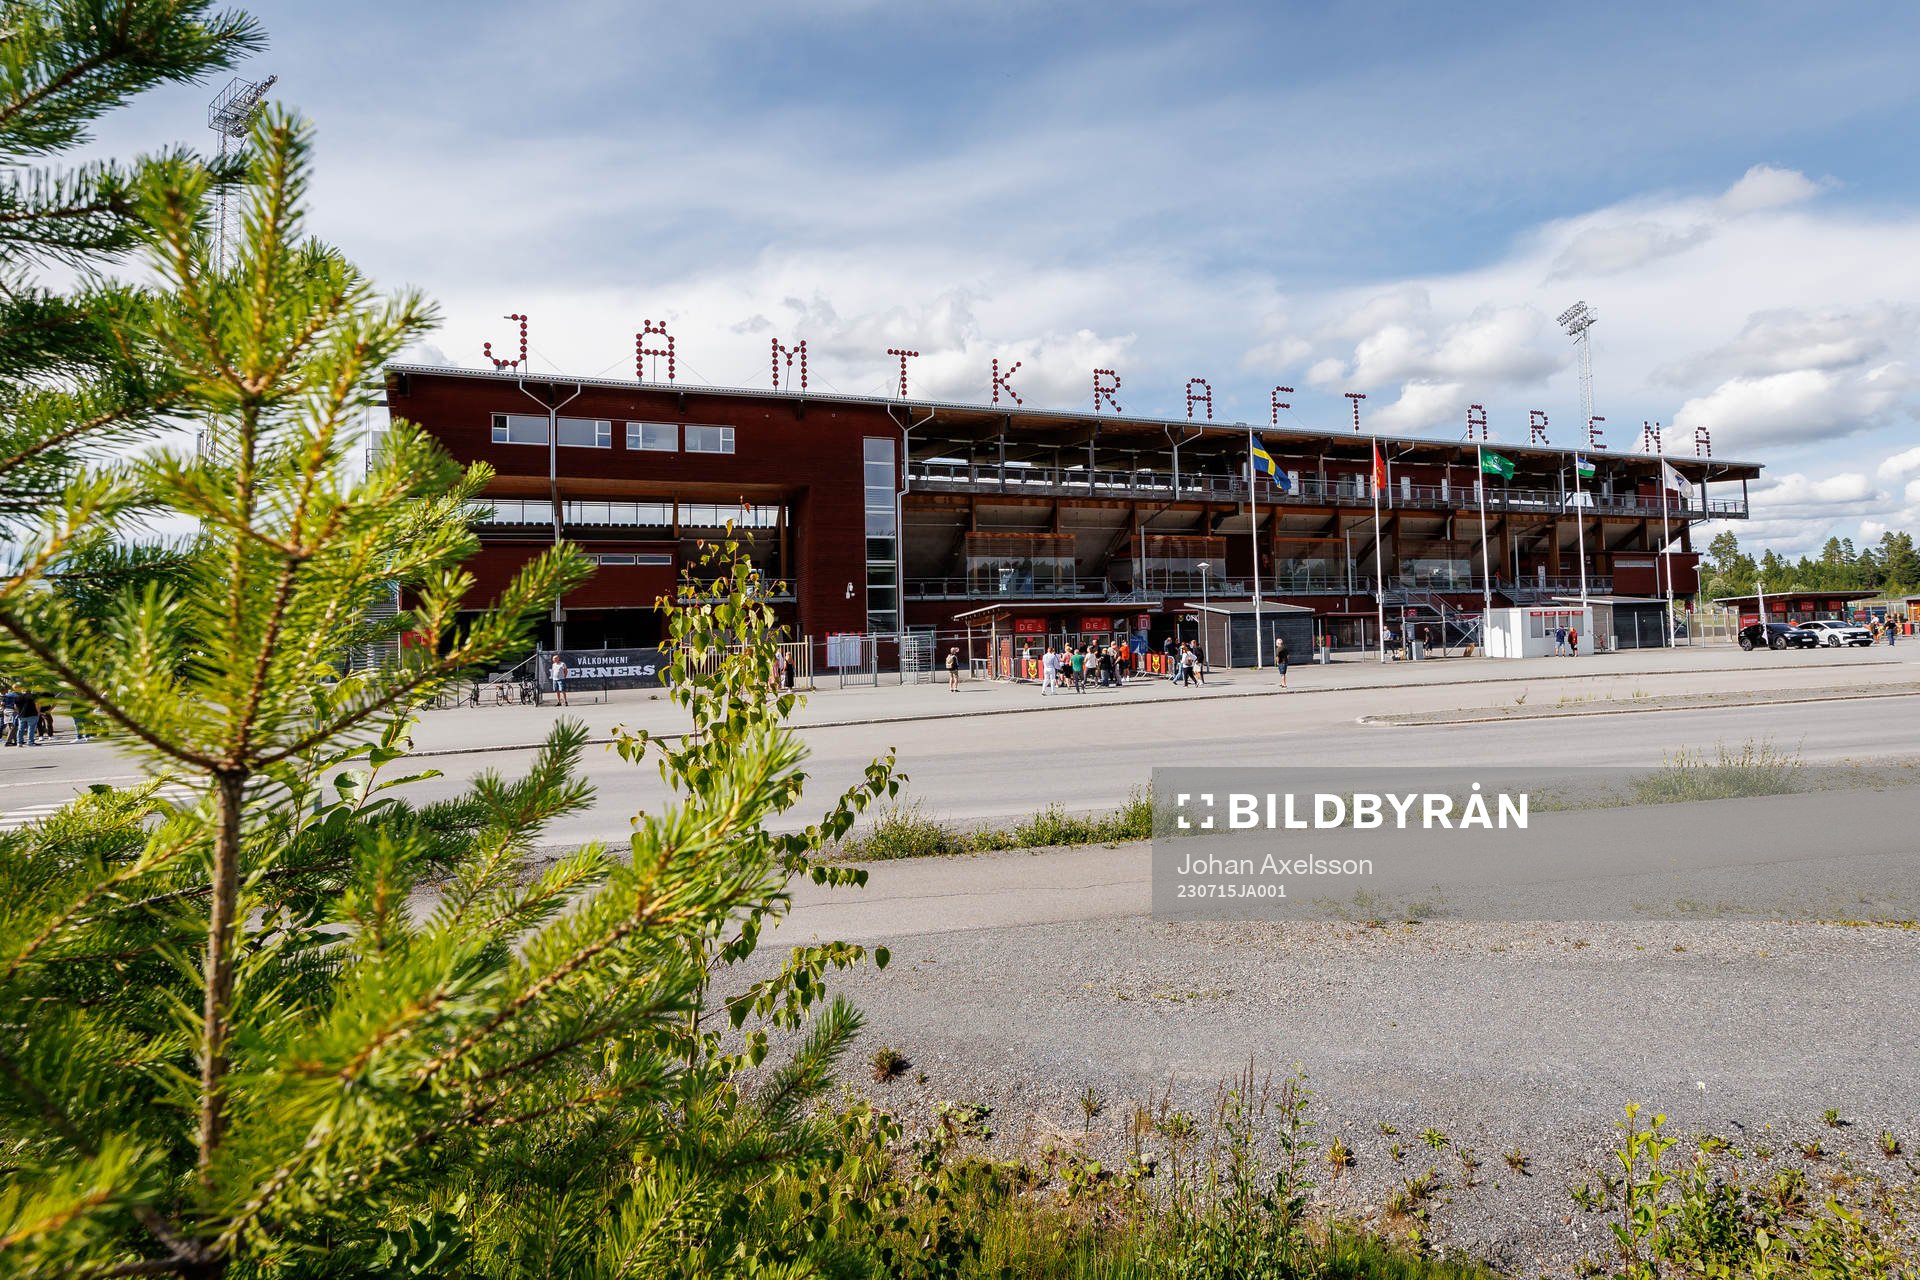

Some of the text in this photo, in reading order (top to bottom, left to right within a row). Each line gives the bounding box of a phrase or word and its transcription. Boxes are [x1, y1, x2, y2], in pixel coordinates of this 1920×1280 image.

[484, 313, 1712, 458] JÄMTKRAFT ARENA
[577, 656, 628, 665] VÄLKOMMEN!
[549, 664, 656, 678] ERNERS
